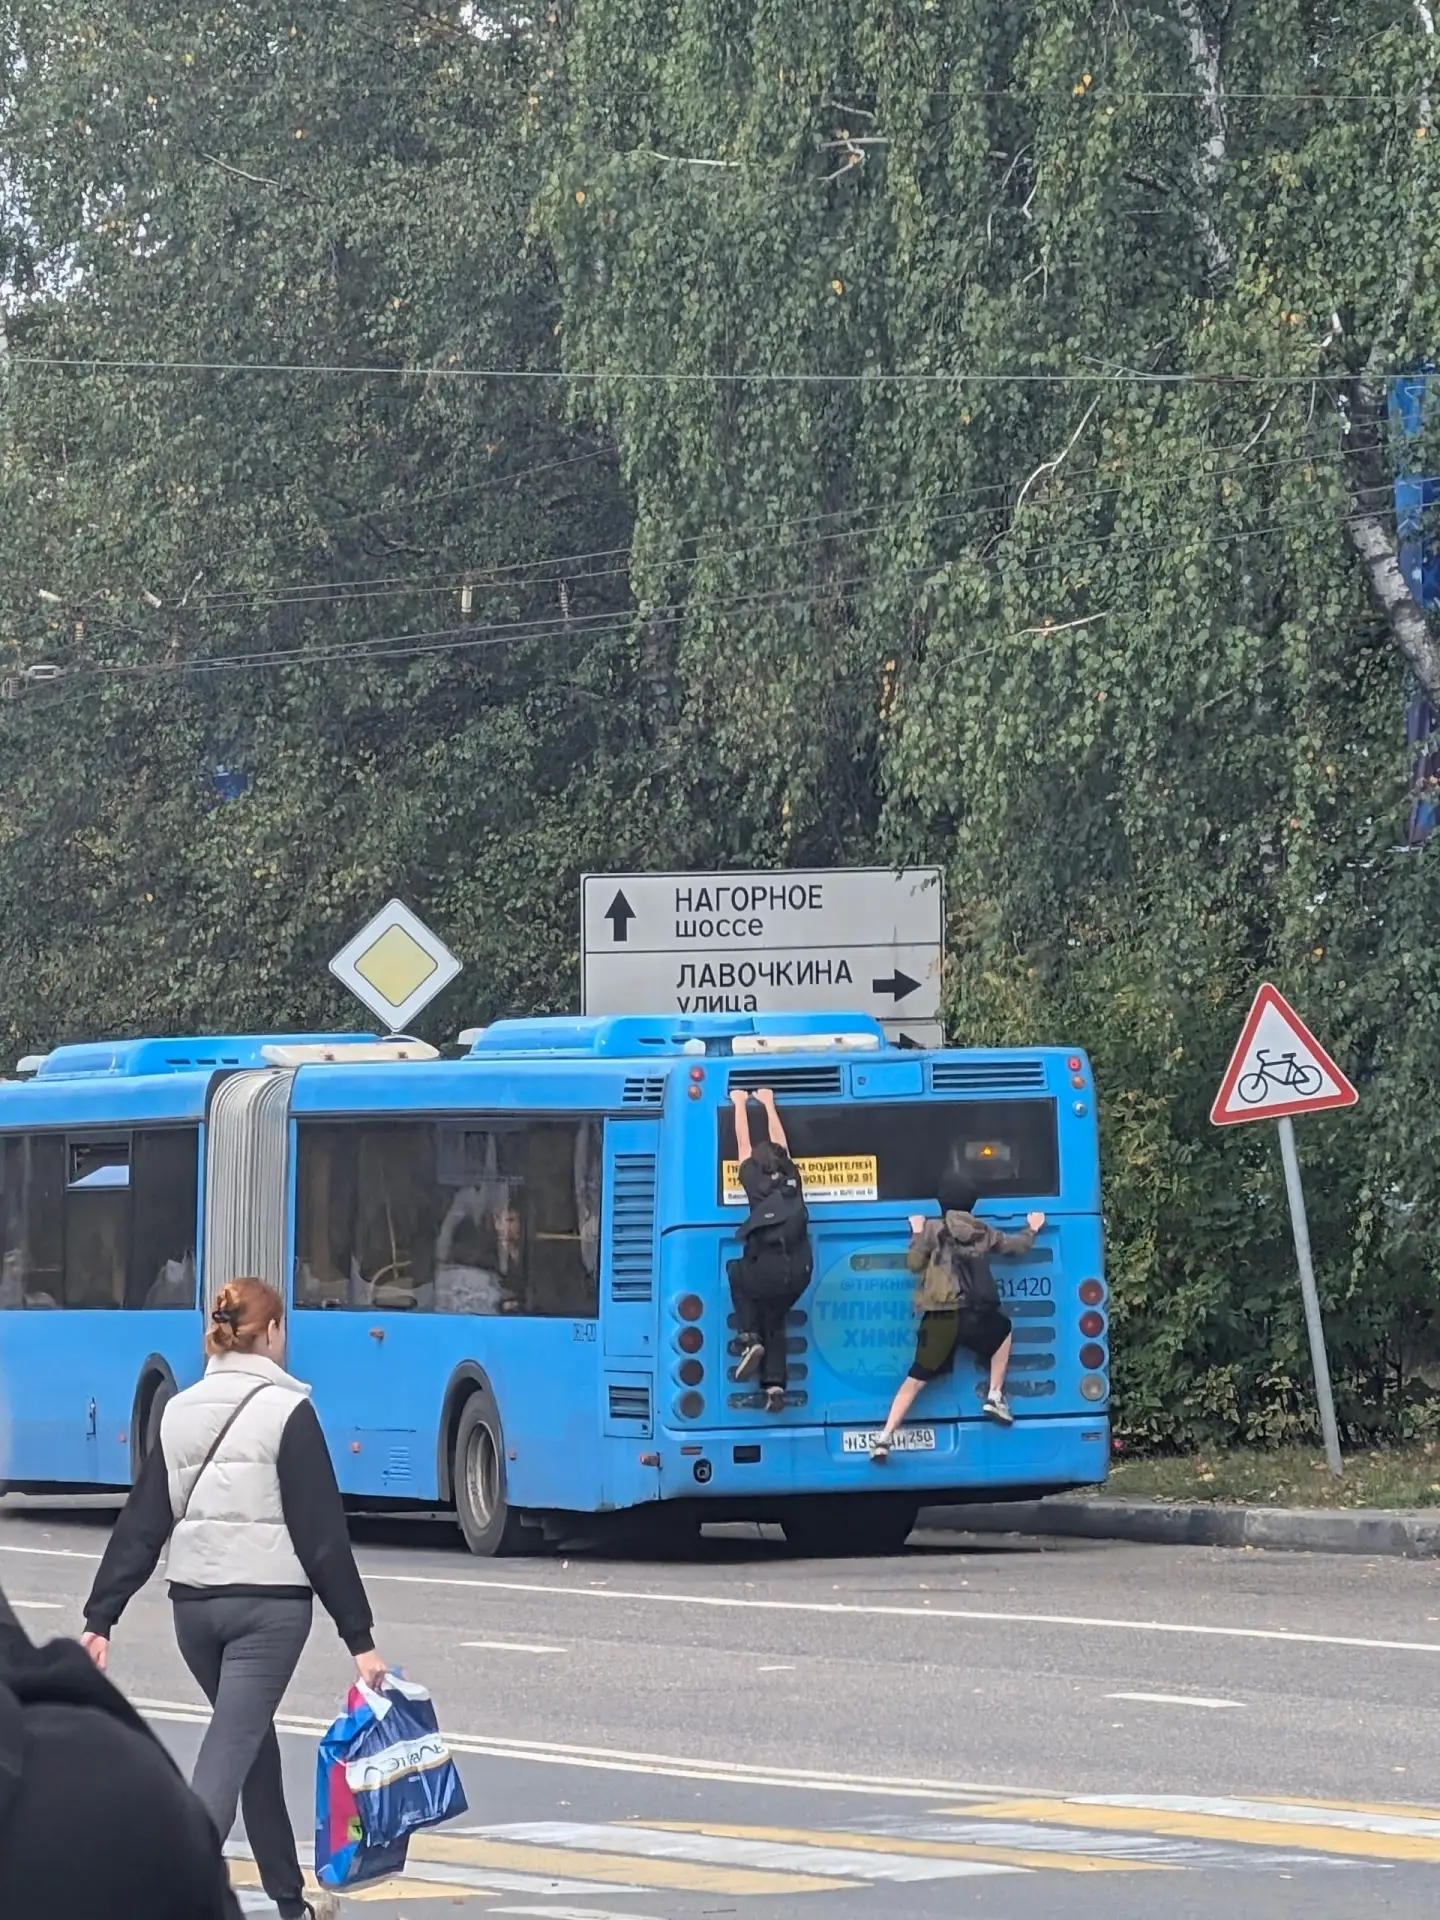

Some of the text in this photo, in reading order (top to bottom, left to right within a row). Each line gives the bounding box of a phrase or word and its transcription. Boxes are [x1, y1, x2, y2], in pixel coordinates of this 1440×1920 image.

[675, 884, 823, 912] НАГОРНОЕ
[675, 917, 764, 938] шоссе
[676, 959, 853, 989] ЛАВОЧКИНА
[676, 993, 758, 1013] улица
